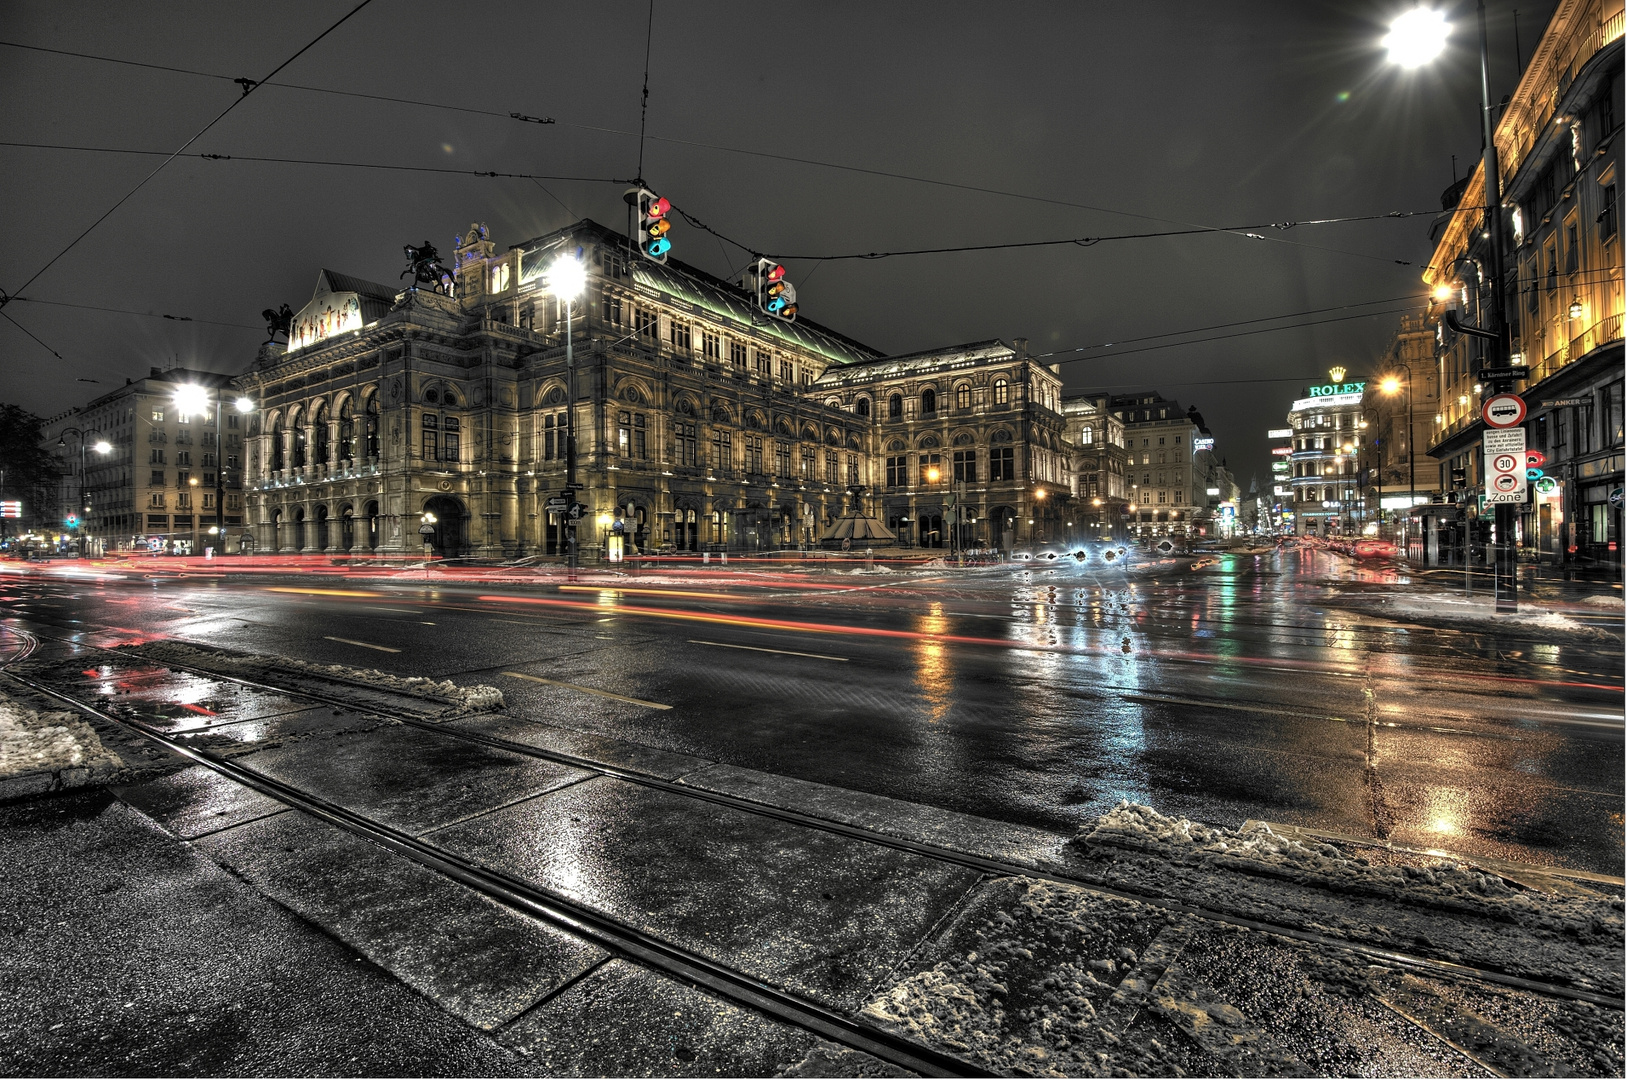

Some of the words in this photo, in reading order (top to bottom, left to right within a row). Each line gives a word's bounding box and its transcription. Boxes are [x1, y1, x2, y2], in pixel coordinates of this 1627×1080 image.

[1309, 382, 1366, 396] ROLEX
[1554, 399, 1581, 407] ANKER
[1500, 459, 1510, 468] 30
[1492, 493, 1521, 502] Zone
